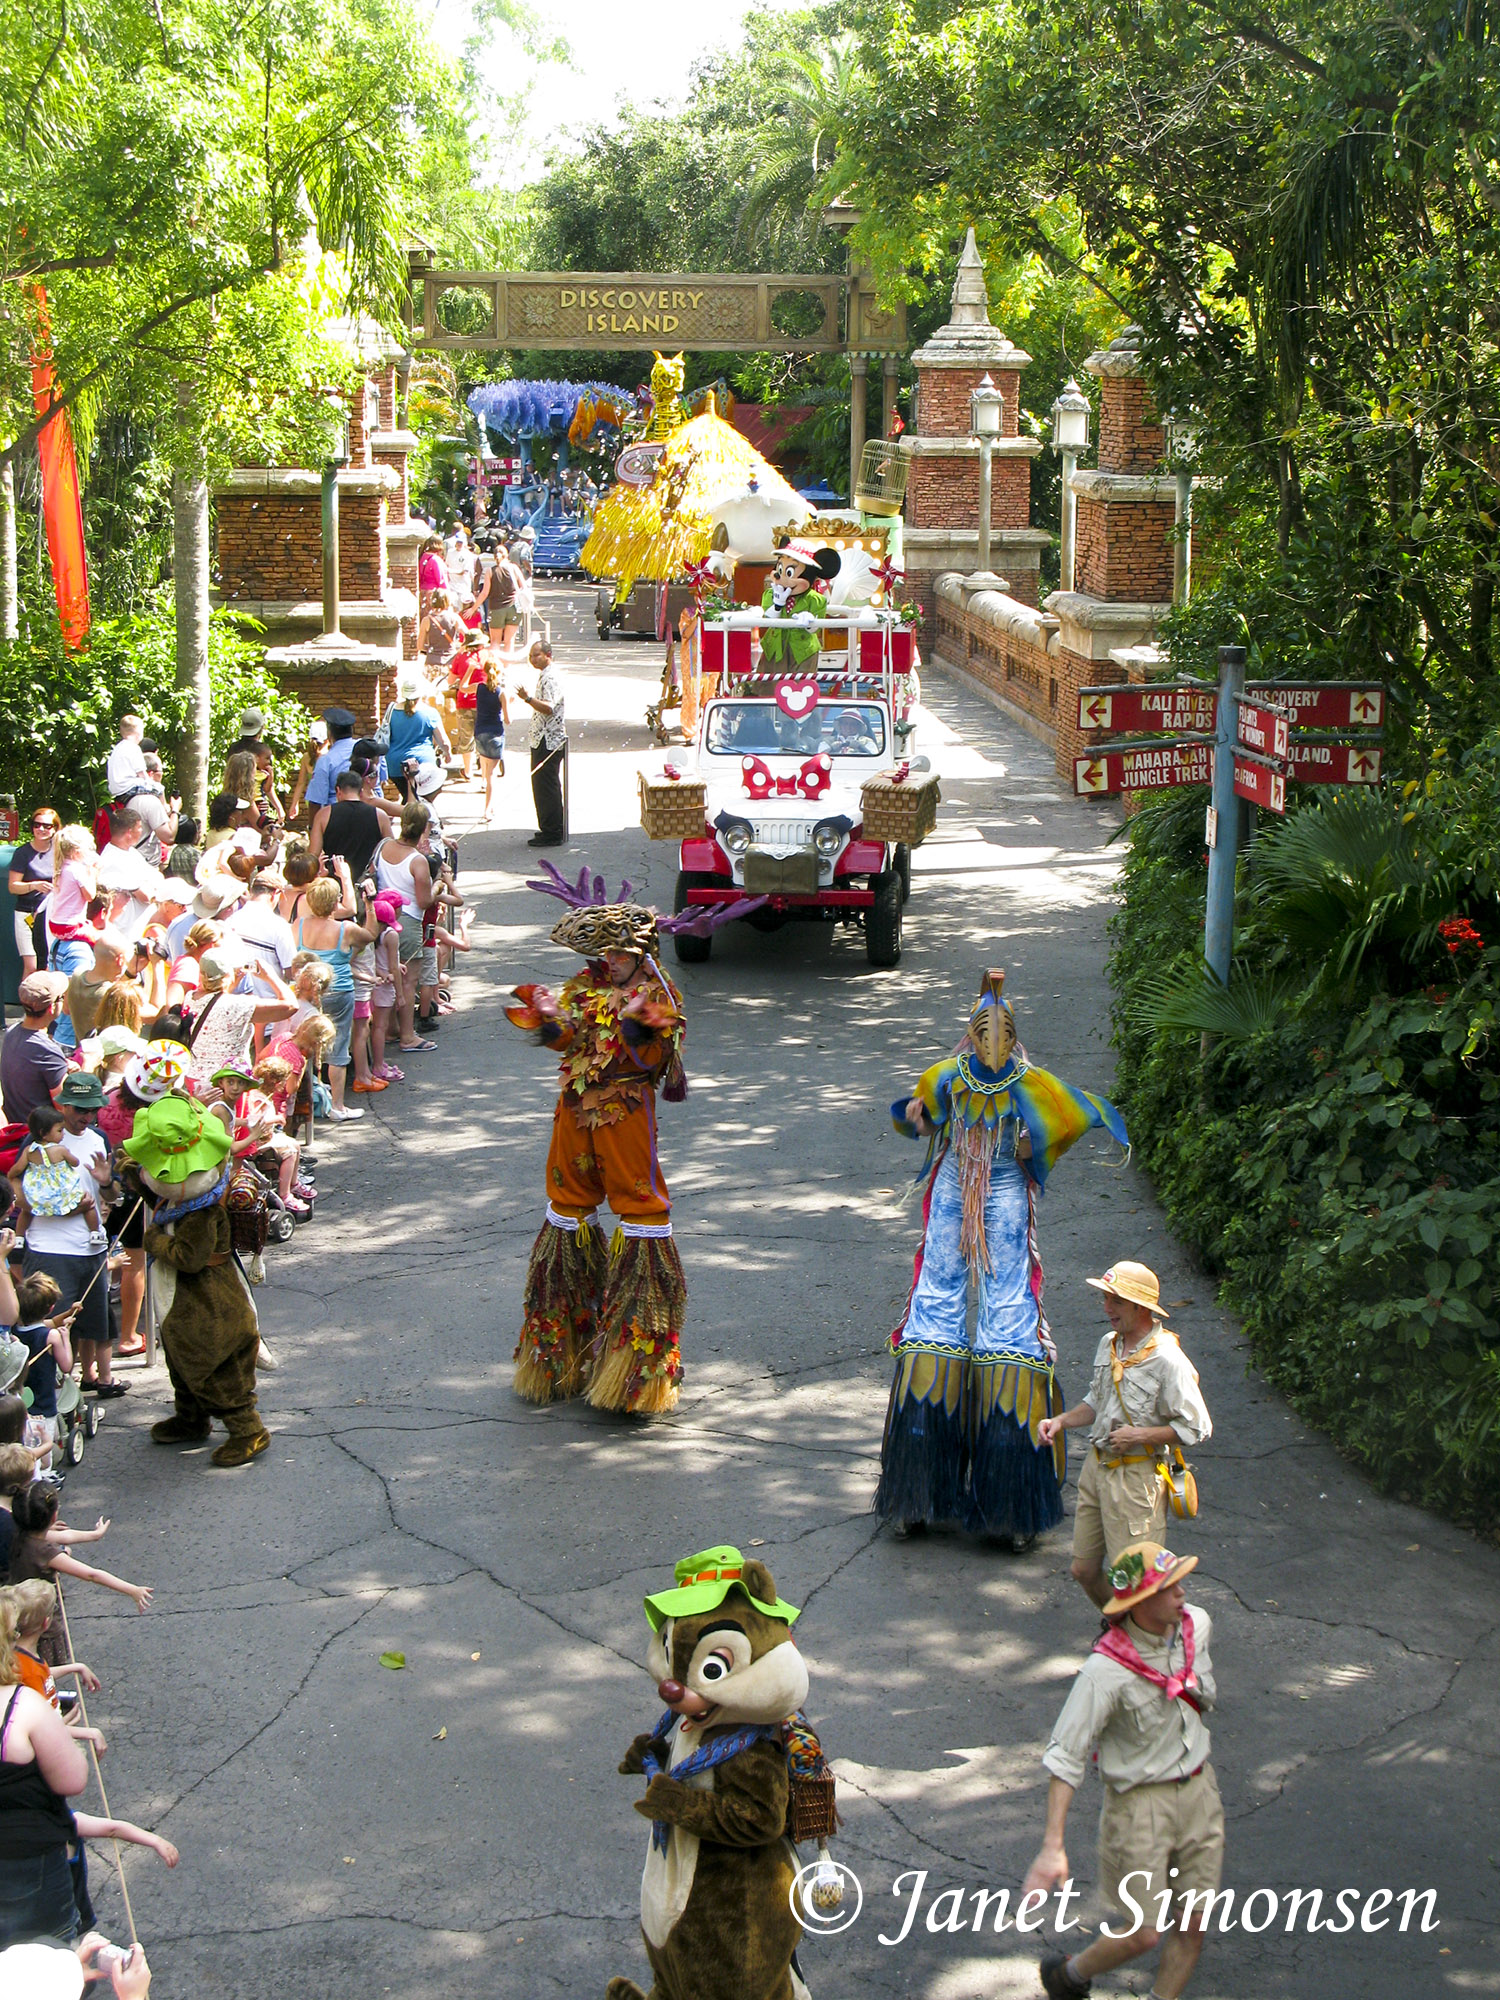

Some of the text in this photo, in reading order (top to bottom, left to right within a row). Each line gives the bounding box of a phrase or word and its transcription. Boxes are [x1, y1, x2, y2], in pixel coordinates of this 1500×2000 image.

[561, 290, 704, 310] DISCOVERY
[587, 314, 680, 333] ISLAND
[1142, 695, 1214, 712] KALI RIVER
[1251, 690, 1321, 707] DISCOVERY
[1162, 712, 1213, 728] RAPIDS
[1122, 747, 1207, 771] MAHARAJAH
[1120, 768, 1170, 788] JUNGLE
[1174, 765, 1208, 783] TREK
